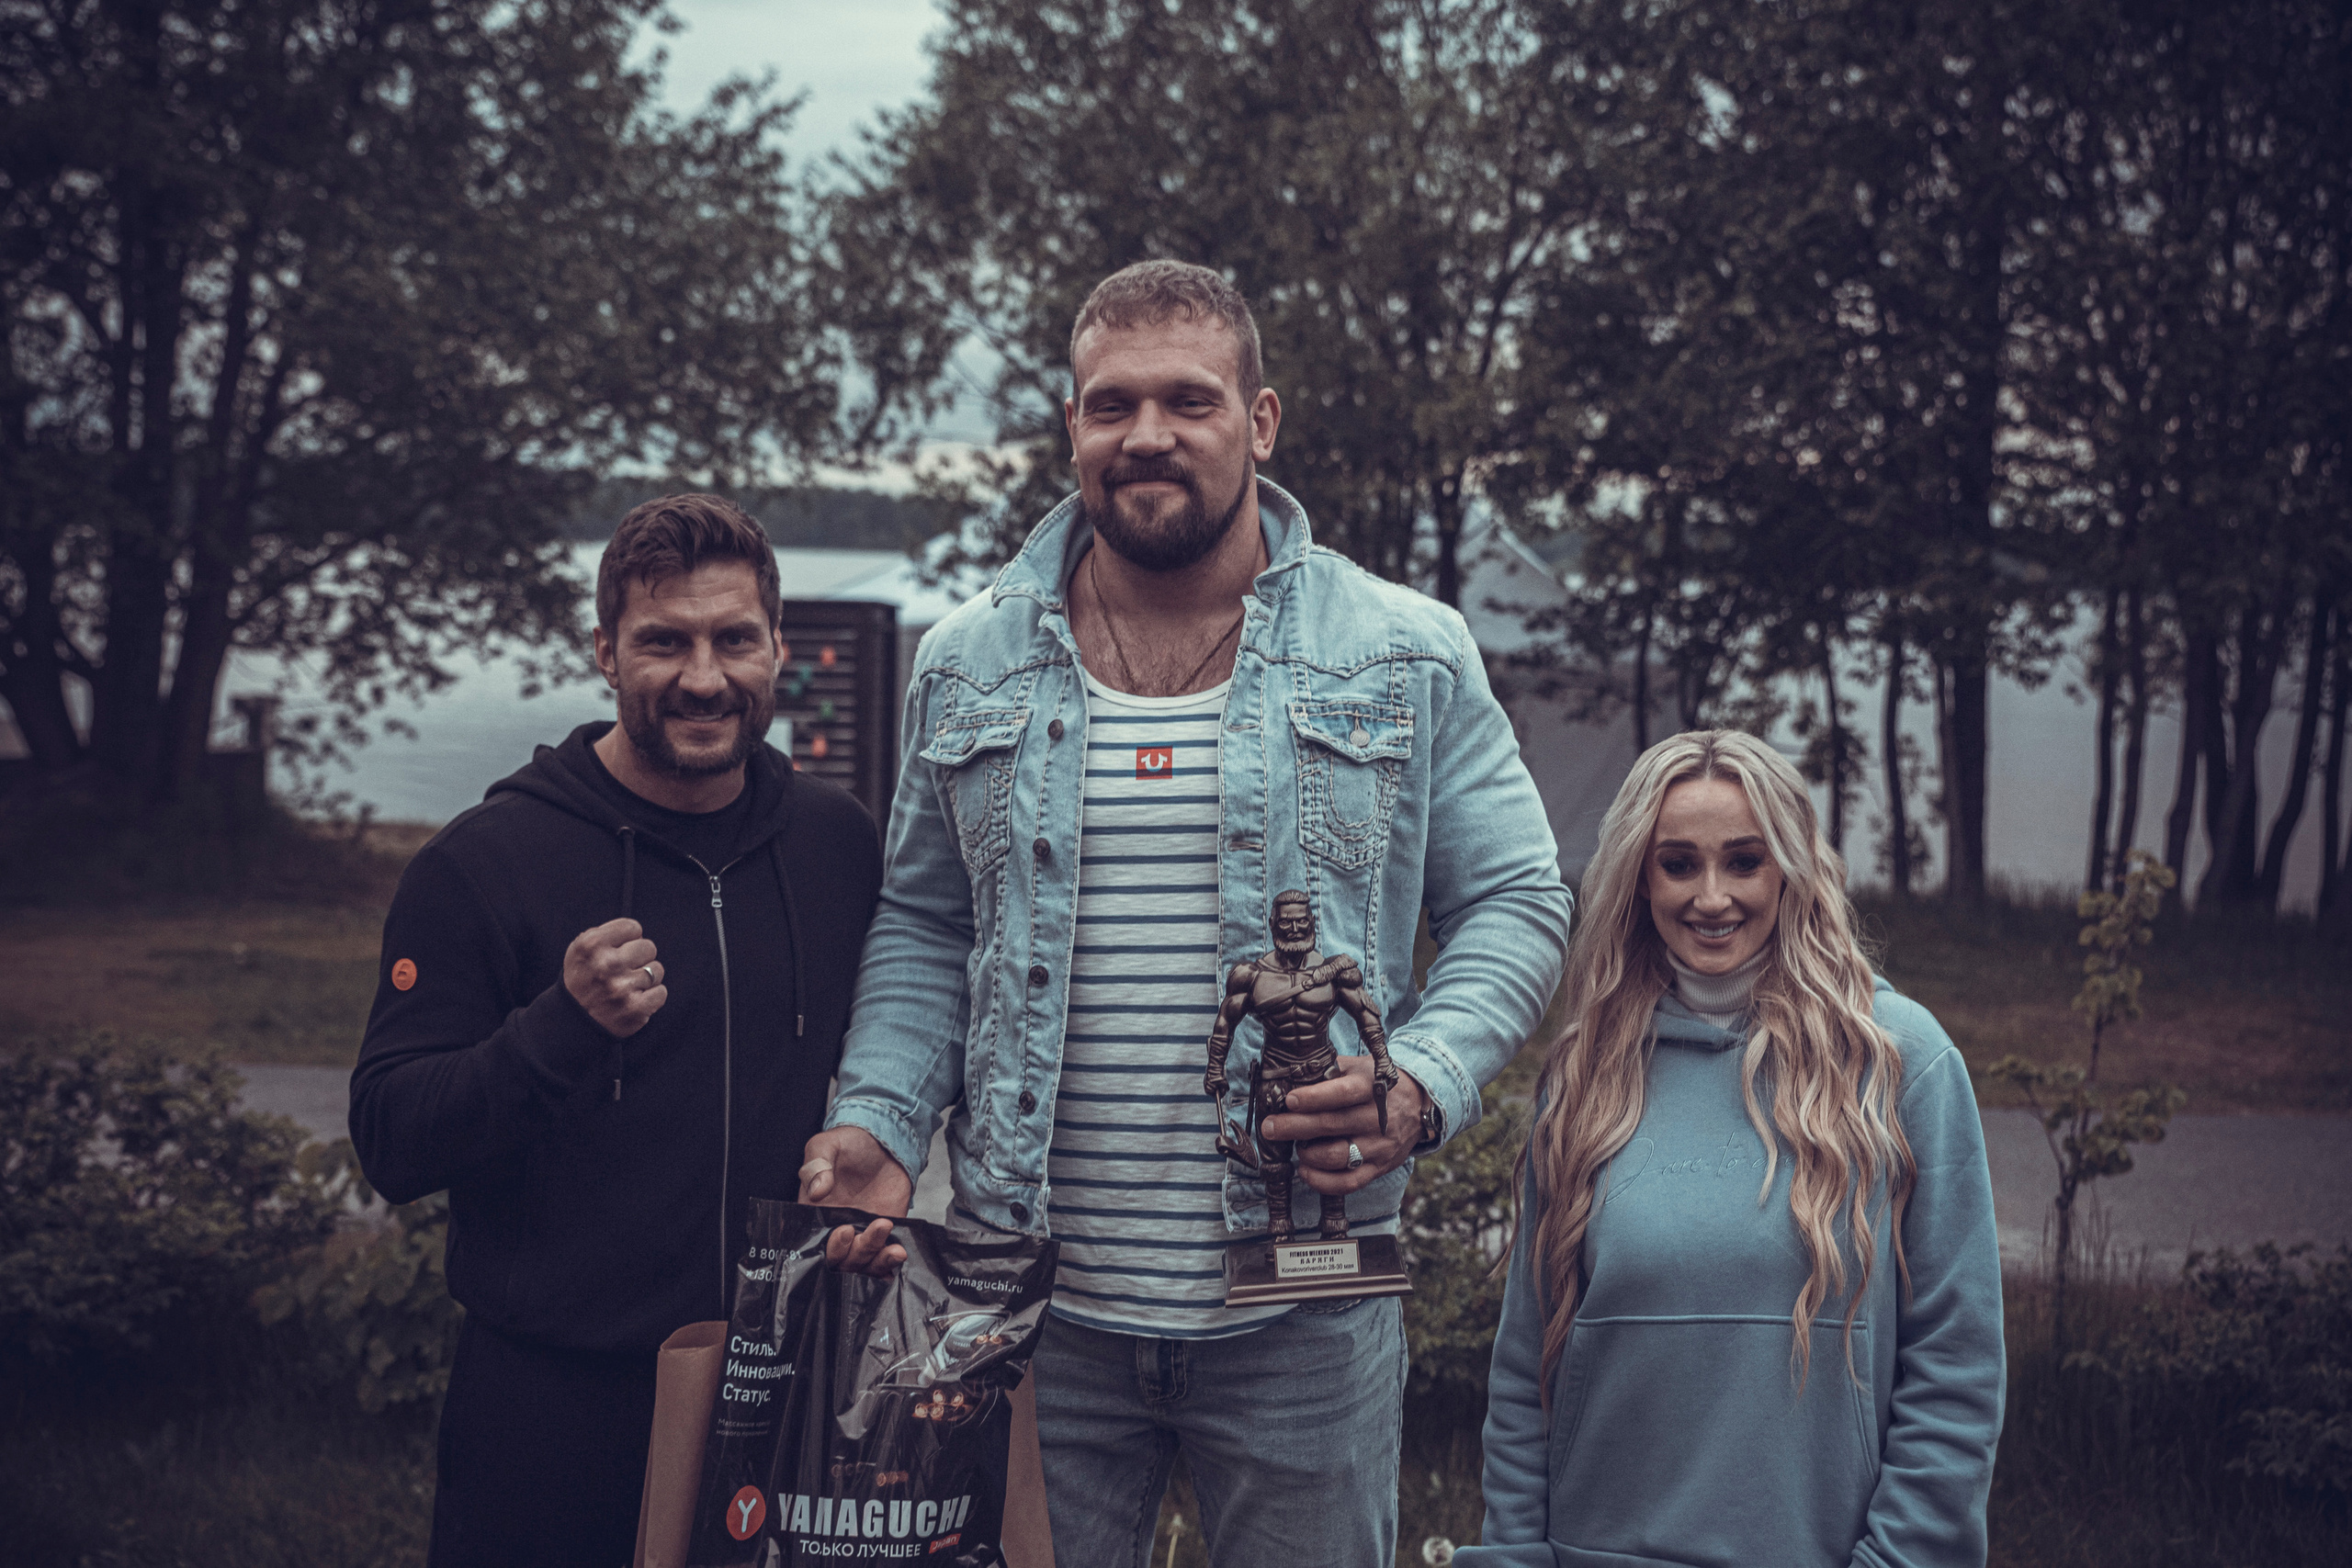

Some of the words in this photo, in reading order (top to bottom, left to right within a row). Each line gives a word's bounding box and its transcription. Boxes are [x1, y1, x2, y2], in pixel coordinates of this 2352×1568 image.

[1716, 1132, 1744, 1178] to
[749, 1247, 756, 1258] 8
[947, 1275, 1023, 1294] yamaguchi.ru
[730, 1336, 776, 1357] Стиль.
[726, 1359, 796, 1380] Инновации.
[722, 1382, 771, 1407] Статус.
[799, 1540, 854, 1557] ТОЬКО
[856, 1543, 922, 1558] ЛУЧШЕЕ
